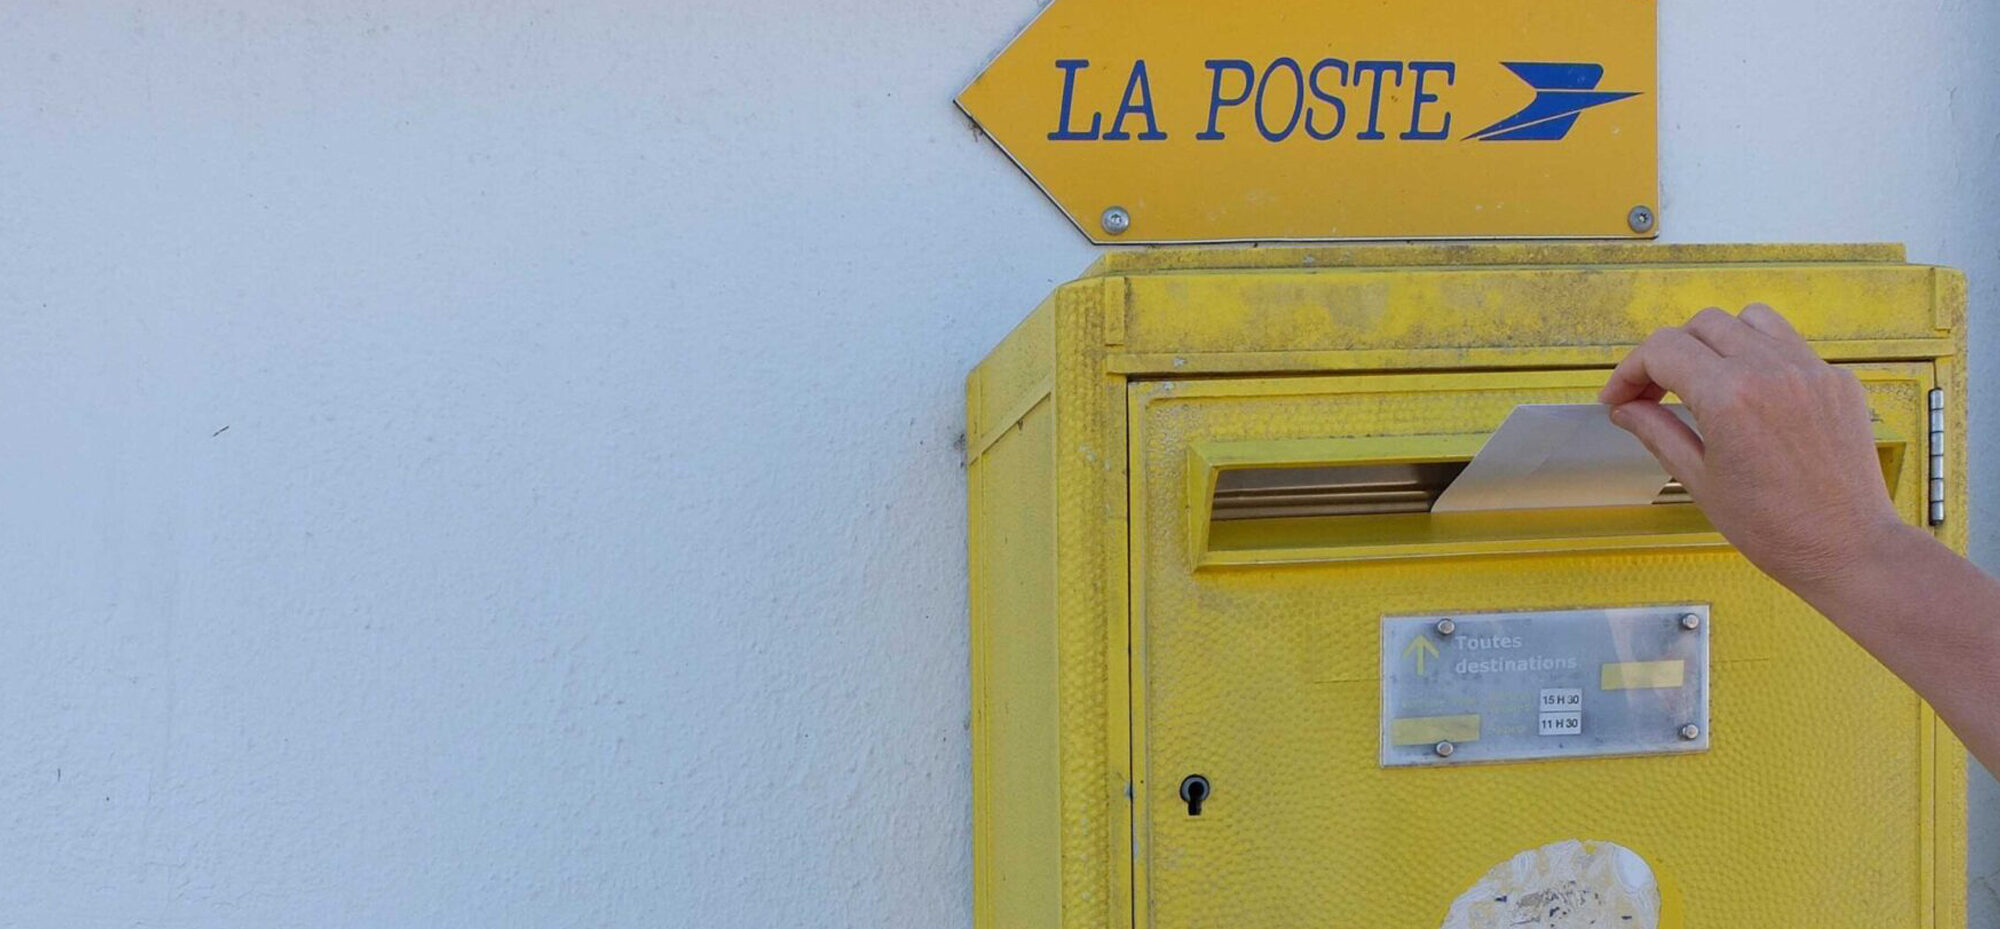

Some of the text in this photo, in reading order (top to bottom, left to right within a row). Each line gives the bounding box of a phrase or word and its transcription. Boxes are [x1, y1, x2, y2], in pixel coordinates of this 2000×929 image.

[1047, 57, 1456, 142] LA POSTE
[1455, 635, 1522, 650] Toutes
[1455, 656, 1577, 674] destinations
[1543, 695, 1555, 704] 15
[1557, 696, 1565, 704] H
[1567, 694, 1579, 704] 30
[1542, 718, 1578, 728] 11 H 30
